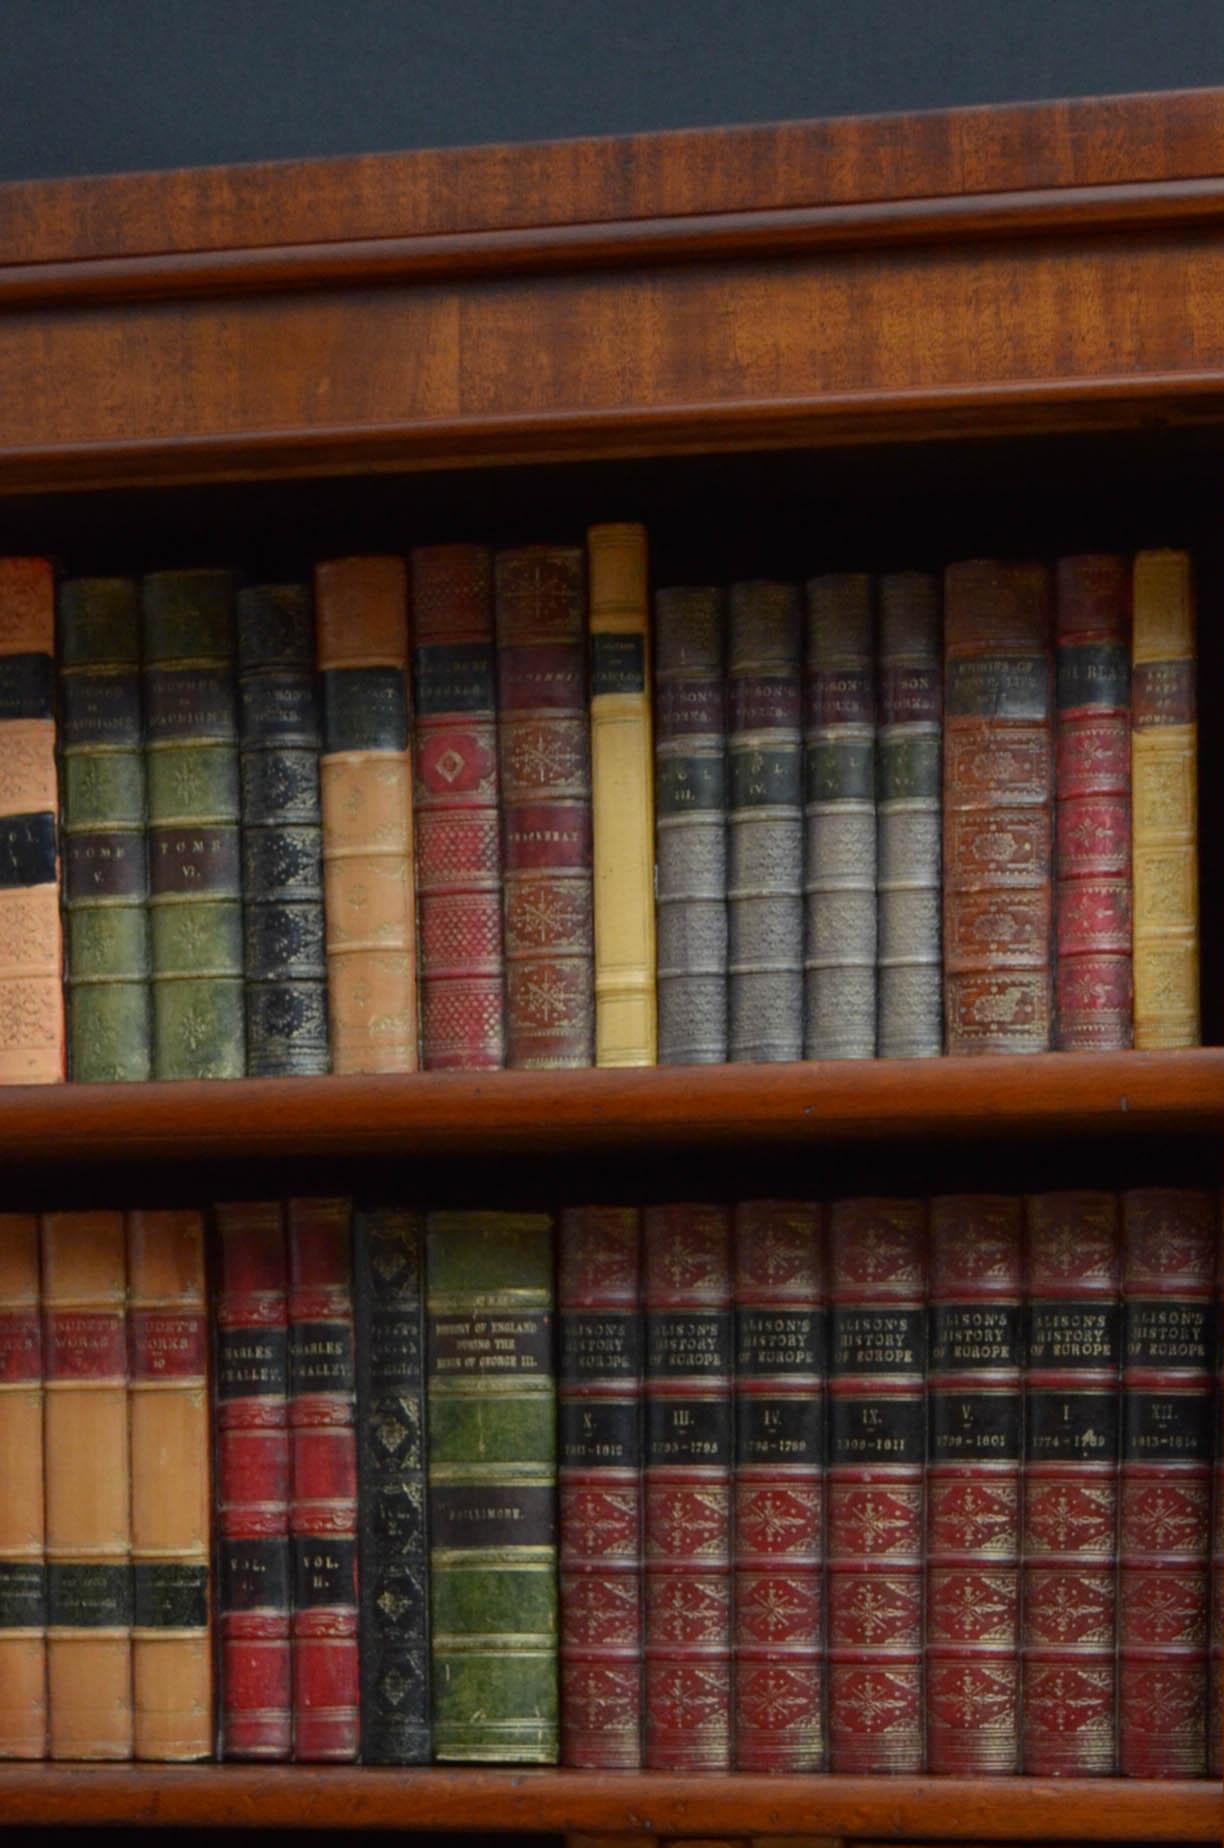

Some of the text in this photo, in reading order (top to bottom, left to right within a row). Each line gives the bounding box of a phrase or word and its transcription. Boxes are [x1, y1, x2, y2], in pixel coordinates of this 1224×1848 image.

[160, 839, 221, 856] TOME
[491, 1319, 538, 1334] ENGLAND
[494, 1337, 516, 1350] THE
[840, 1334, 905, 1348] HISTORY
[856, 1350, 913, 1363] EUROPE
[953, 1345, 1010, 1360] EUROPE
[1053, 1345, 1112, 1358] EUROPE
[673, 1409, 695, 1427] III.
[304, 1555, 340, 1570] VOL.
